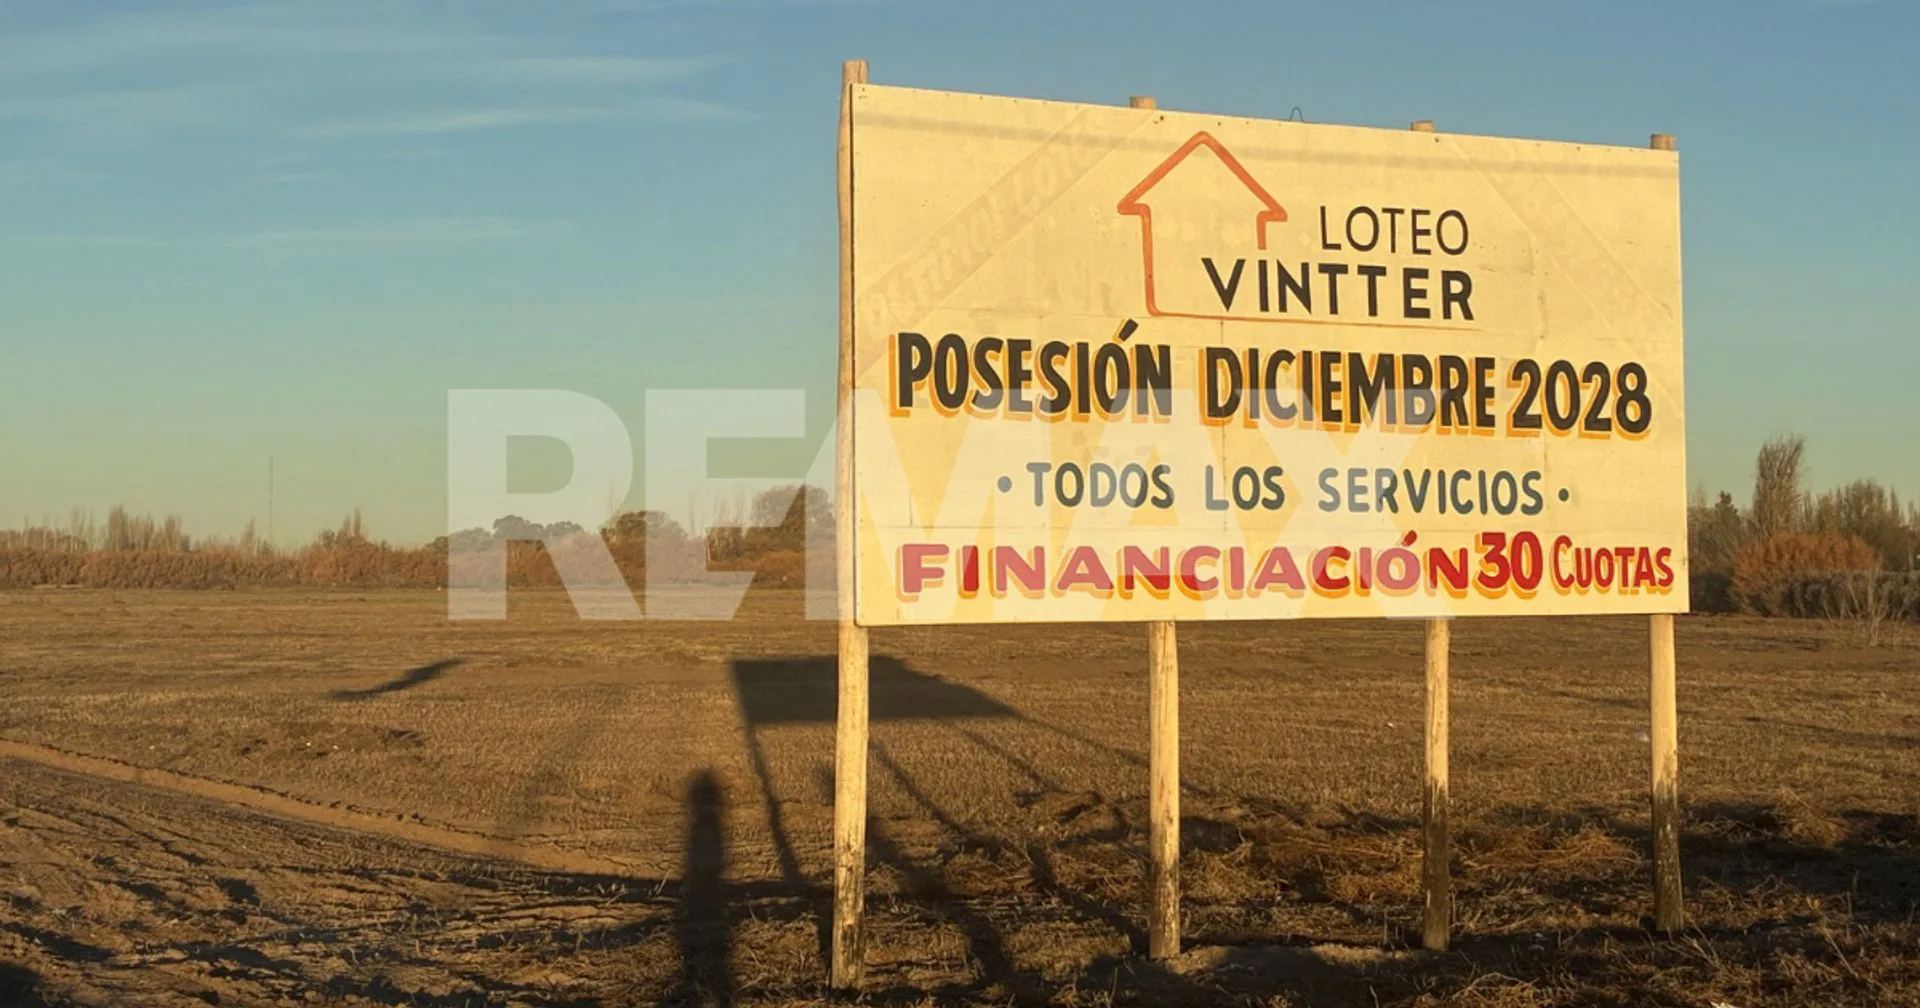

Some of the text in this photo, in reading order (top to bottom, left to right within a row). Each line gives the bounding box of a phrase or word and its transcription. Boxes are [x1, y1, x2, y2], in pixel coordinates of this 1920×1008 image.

[1320, 205, 1469, 256] LOTEO
[1201, 257, 1475, 321] VINTTER
[889, 318, 1653, 441] POSESIÓN DICIEMBRE 2028
[1205, 464, 1286, 511] LOS
[896, 530, 1468, 602] FINANCIACIÓN
[1474, 530, 1544, 600] 30
